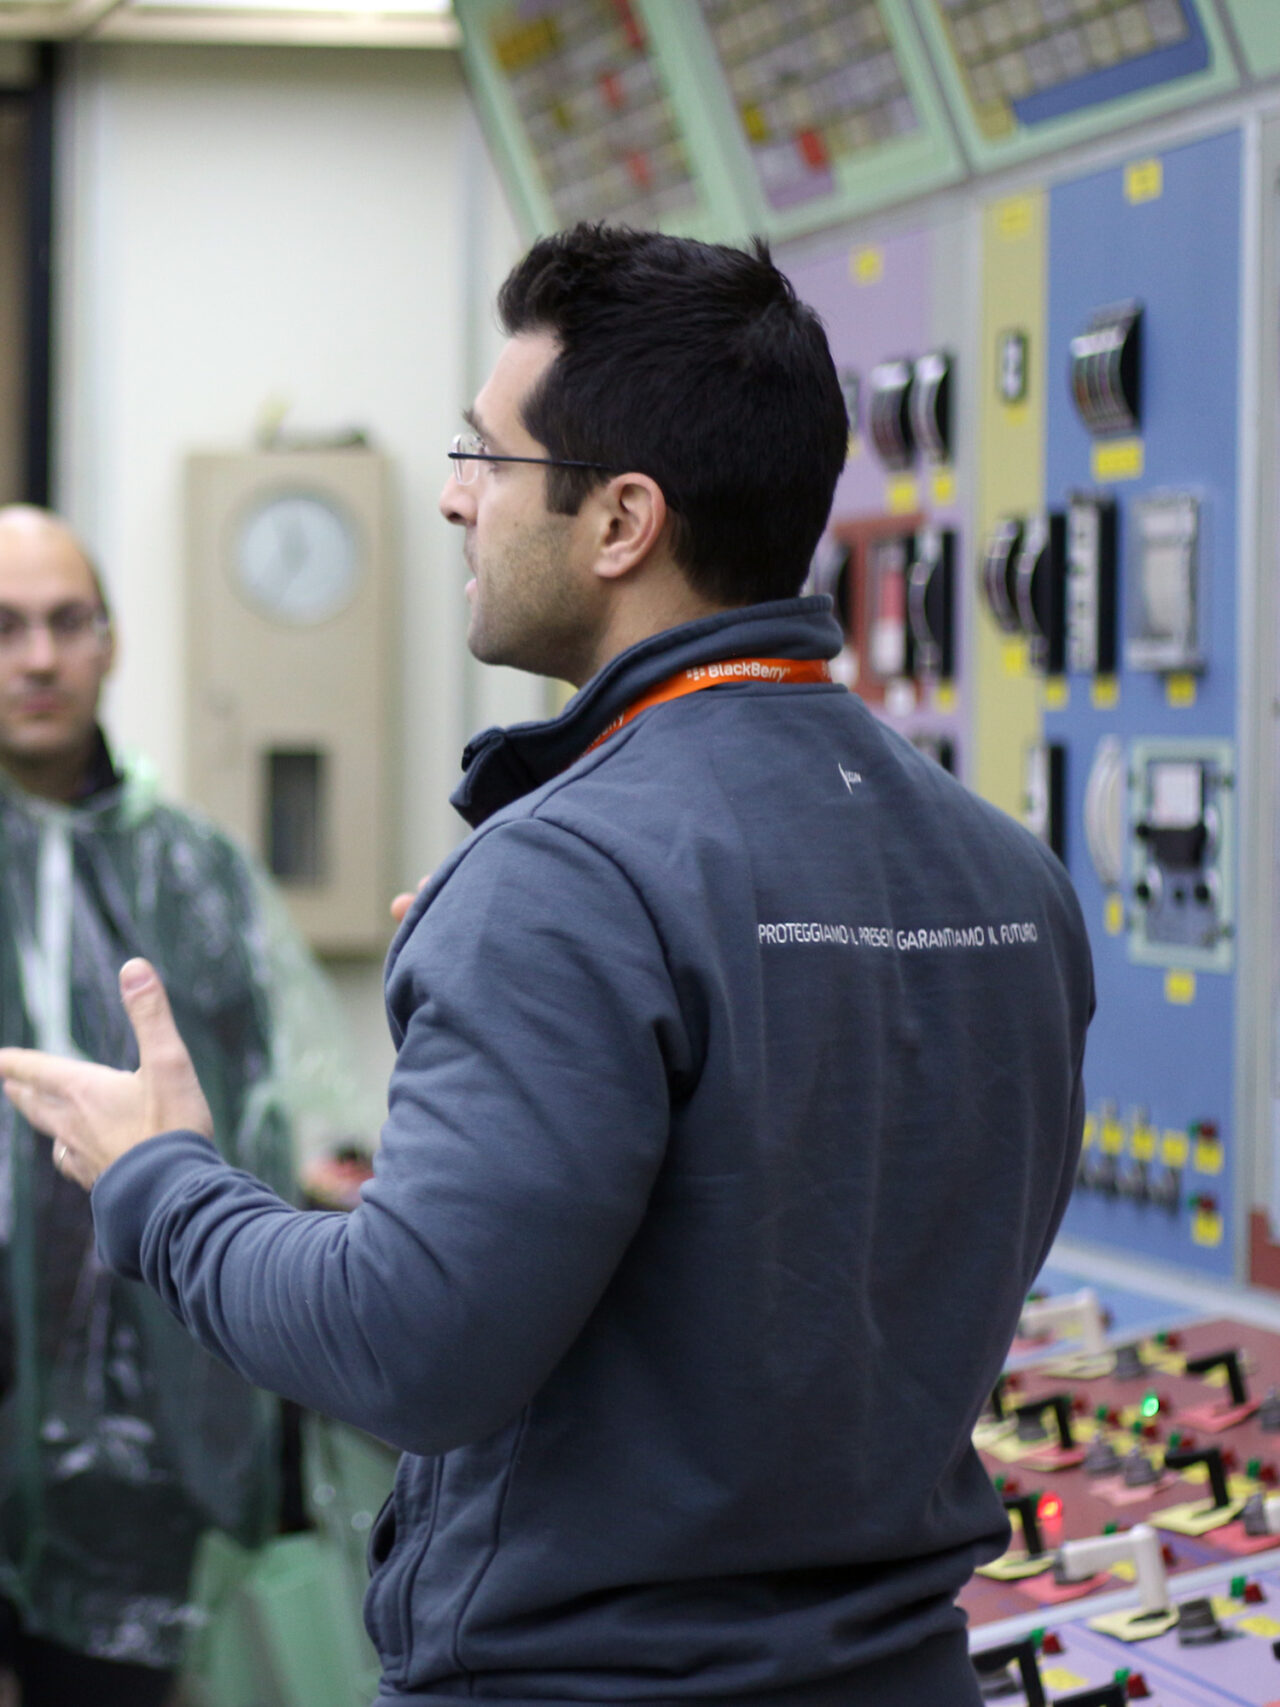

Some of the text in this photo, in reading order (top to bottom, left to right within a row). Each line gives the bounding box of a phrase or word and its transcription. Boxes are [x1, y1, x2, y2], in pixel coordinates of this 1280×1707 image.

[708, 661, 785, 684] BlackBerry
[758, 922, 848, 945] PROTEGGIAMO
[896, 925, 985, 951] GARANTIAMO
